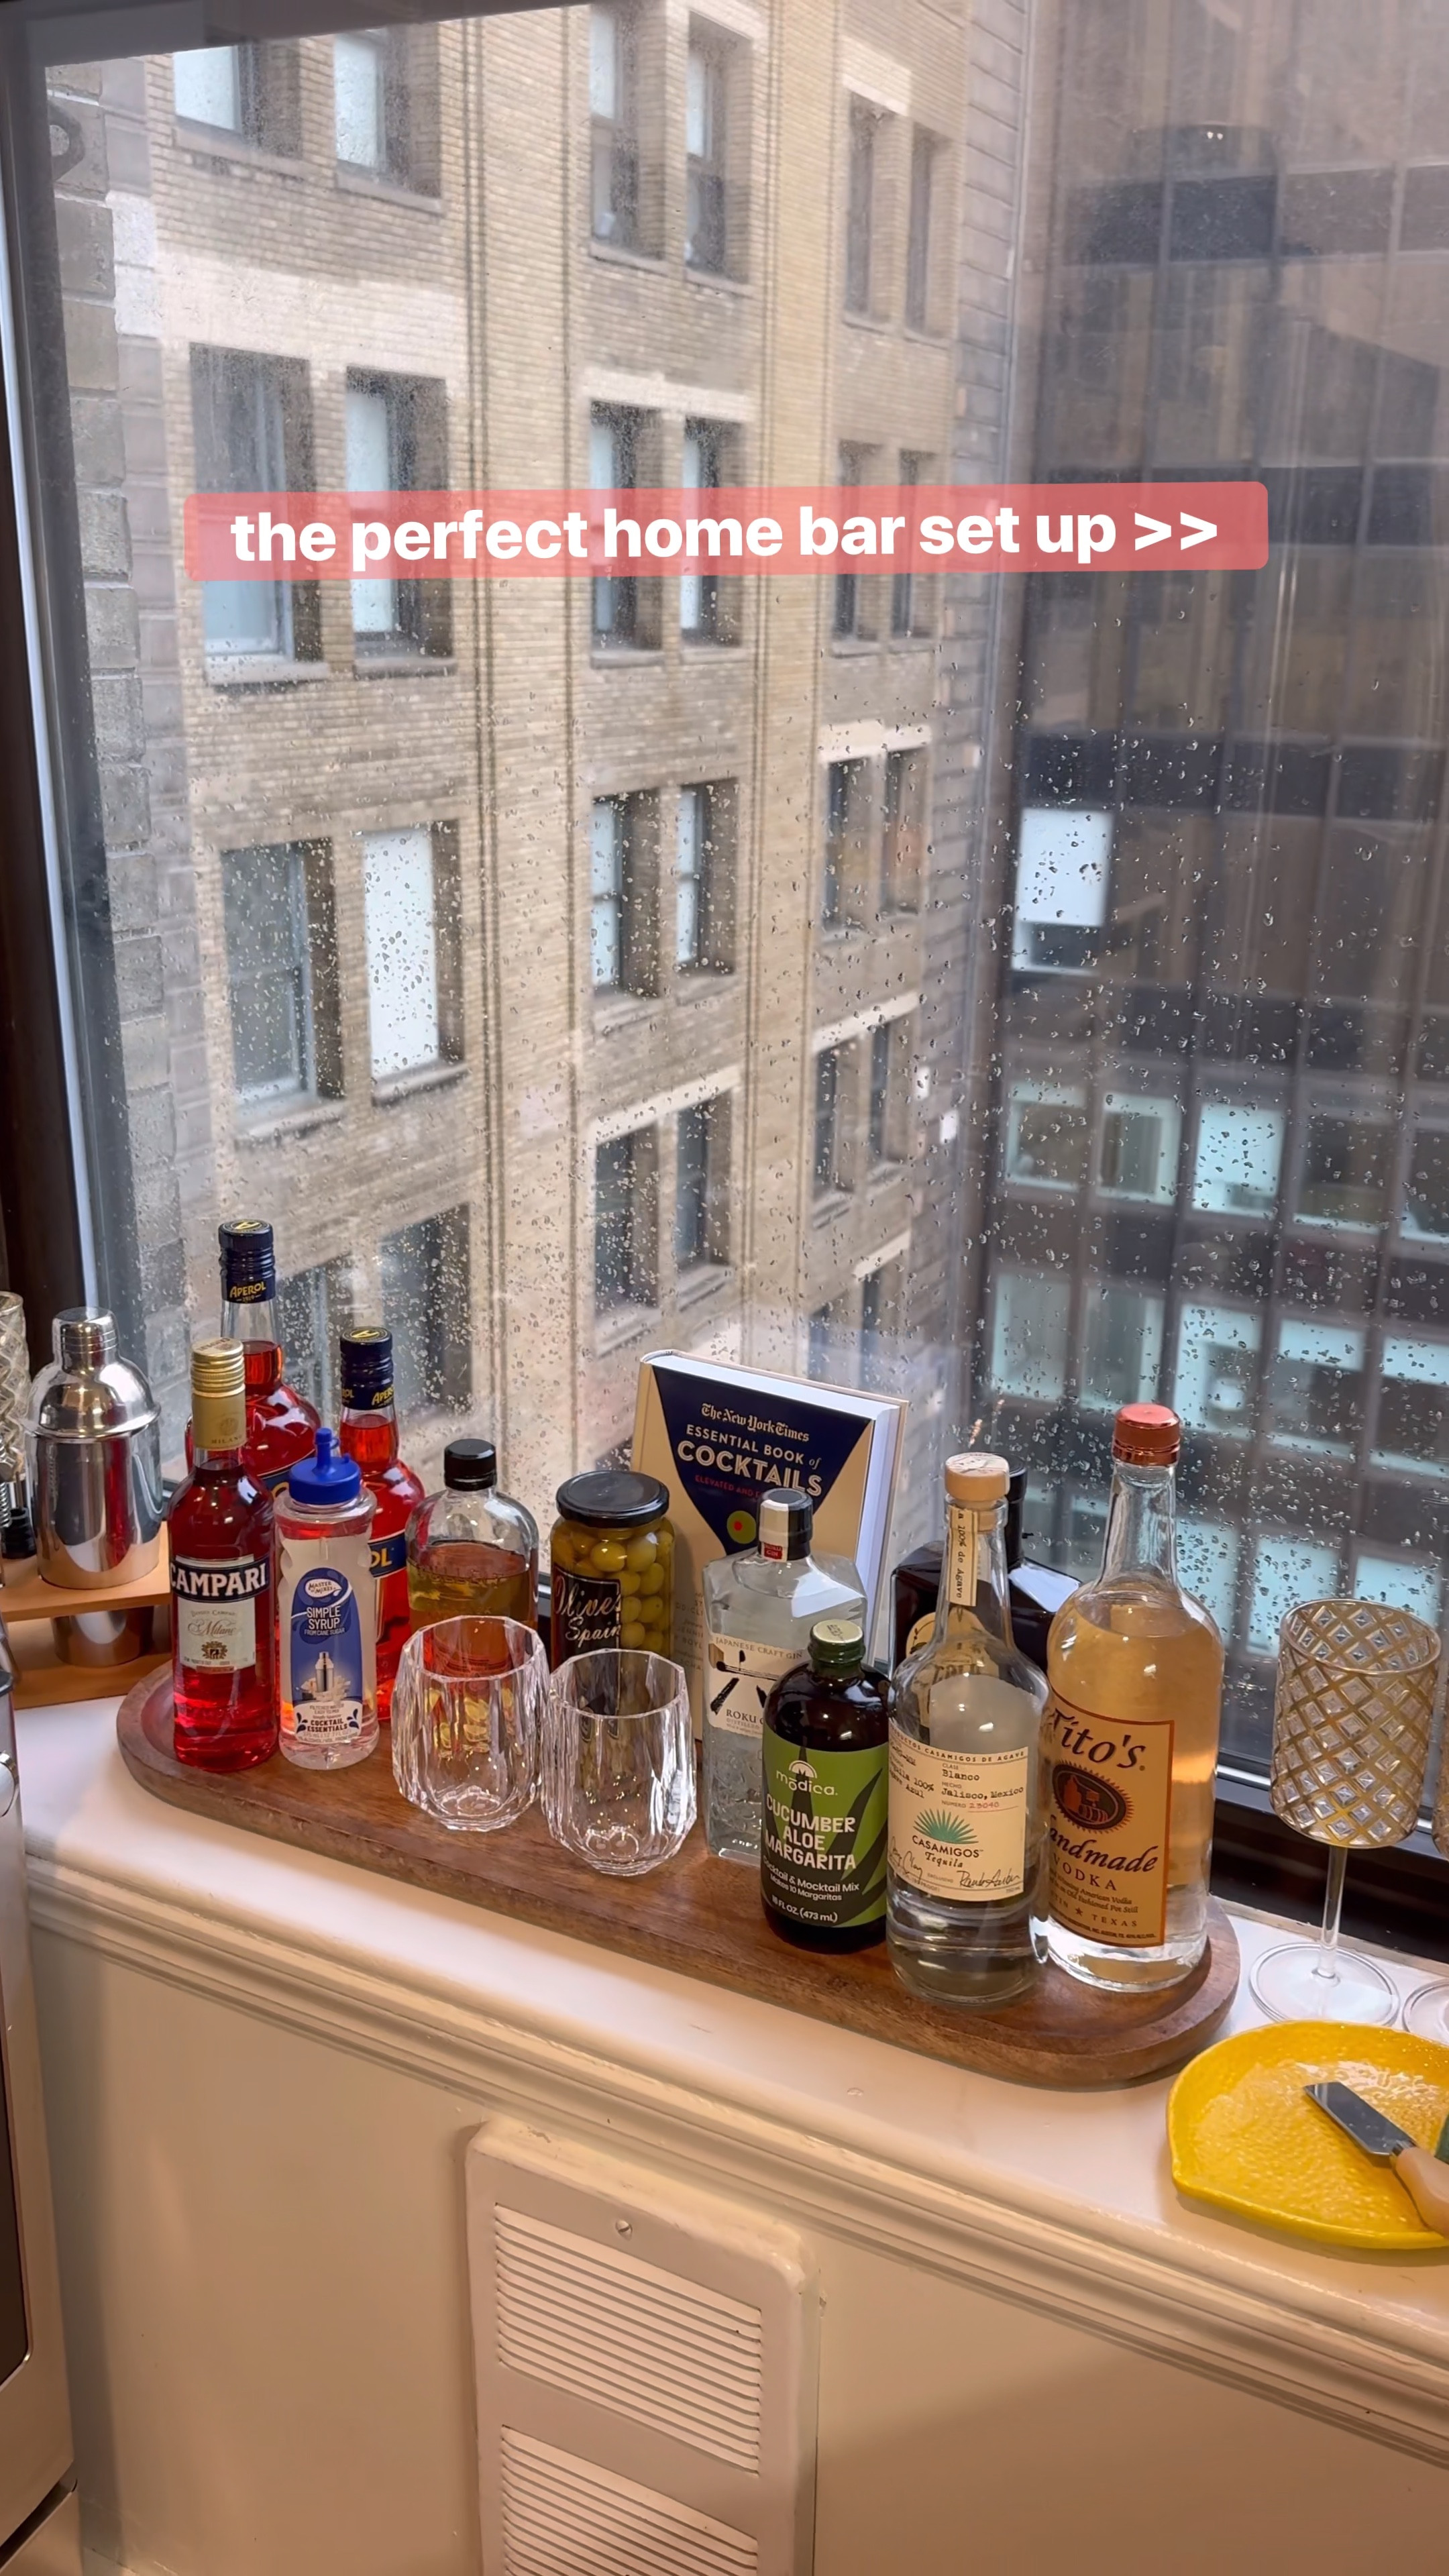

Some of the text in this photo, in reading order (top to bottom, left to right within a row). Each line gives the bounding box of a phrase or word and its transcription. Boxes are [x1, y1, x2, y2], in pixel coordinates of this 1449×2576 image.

[229, 1281, 266, 1298] APEROL
[701, 1403, 810, 1442] The New York Times
[211, 1436, 241, 1444] MILAN
[686, 1424, 822, 1470] ESSENTIAL BOOK of
[677, 1440, 822, 1497] COCKTAILS
[695, 1475, 735, 1492] ELEVATED
[736, 1487, 754, 1497] AND
[170, 1562, 266, 1597] CAMPARI
[308, 1580, 332, 1591] MASTER
[307, 1605, 341, 1618] SIMPLE
[309, 1617, 340, 1630] SYRUP
[715, 1637, 803, 1660] JAPANESE CRAFT GIN
[311, 1718, 343, 1726] COCKTAIL
[726, 1709, 757, 1723] ROKU
[307, 1723, 347, 1733] ESSENTIALS
[1051, 1708, 1146, 1769] Tito's
[924, 1748, 976, 1762] CASAMIGOS
[997, 1751, 1024, 1761] AGAVE
[942, 1768, 980, 1781] Blanco
[914, 1778, 934, 1792] 100%
[941, 1786, 1024, 1801] Jalisco, Mexico
[766, 1793, 856, 1833] CUCUMBER
[783, 1825, 825, 1851] ALOE
[912, 1835, 980, 1858] CASAMIGOS
[1050, 1815, 1159, 1872] andmade
[765, 1829, 857, 1870] MARGARITA
[924, 1851, 964, 1868] Tequila
[763, 1855, 860, 1892] Cocktail & Mocktail Mix
[1053, 1853, 1117, 1891] VODKA
[770, 1874, 843, 1901] Makes 10 Margaritas
[1080, 1888, 1110, 1902] American
[1112, 1896, 1132, 1904] Vodka
[778, 1900, 786, 1910] FL
[799, 1907, 819, 1920] (473
[1091, 1913, 1138, 1927] TEXAS
